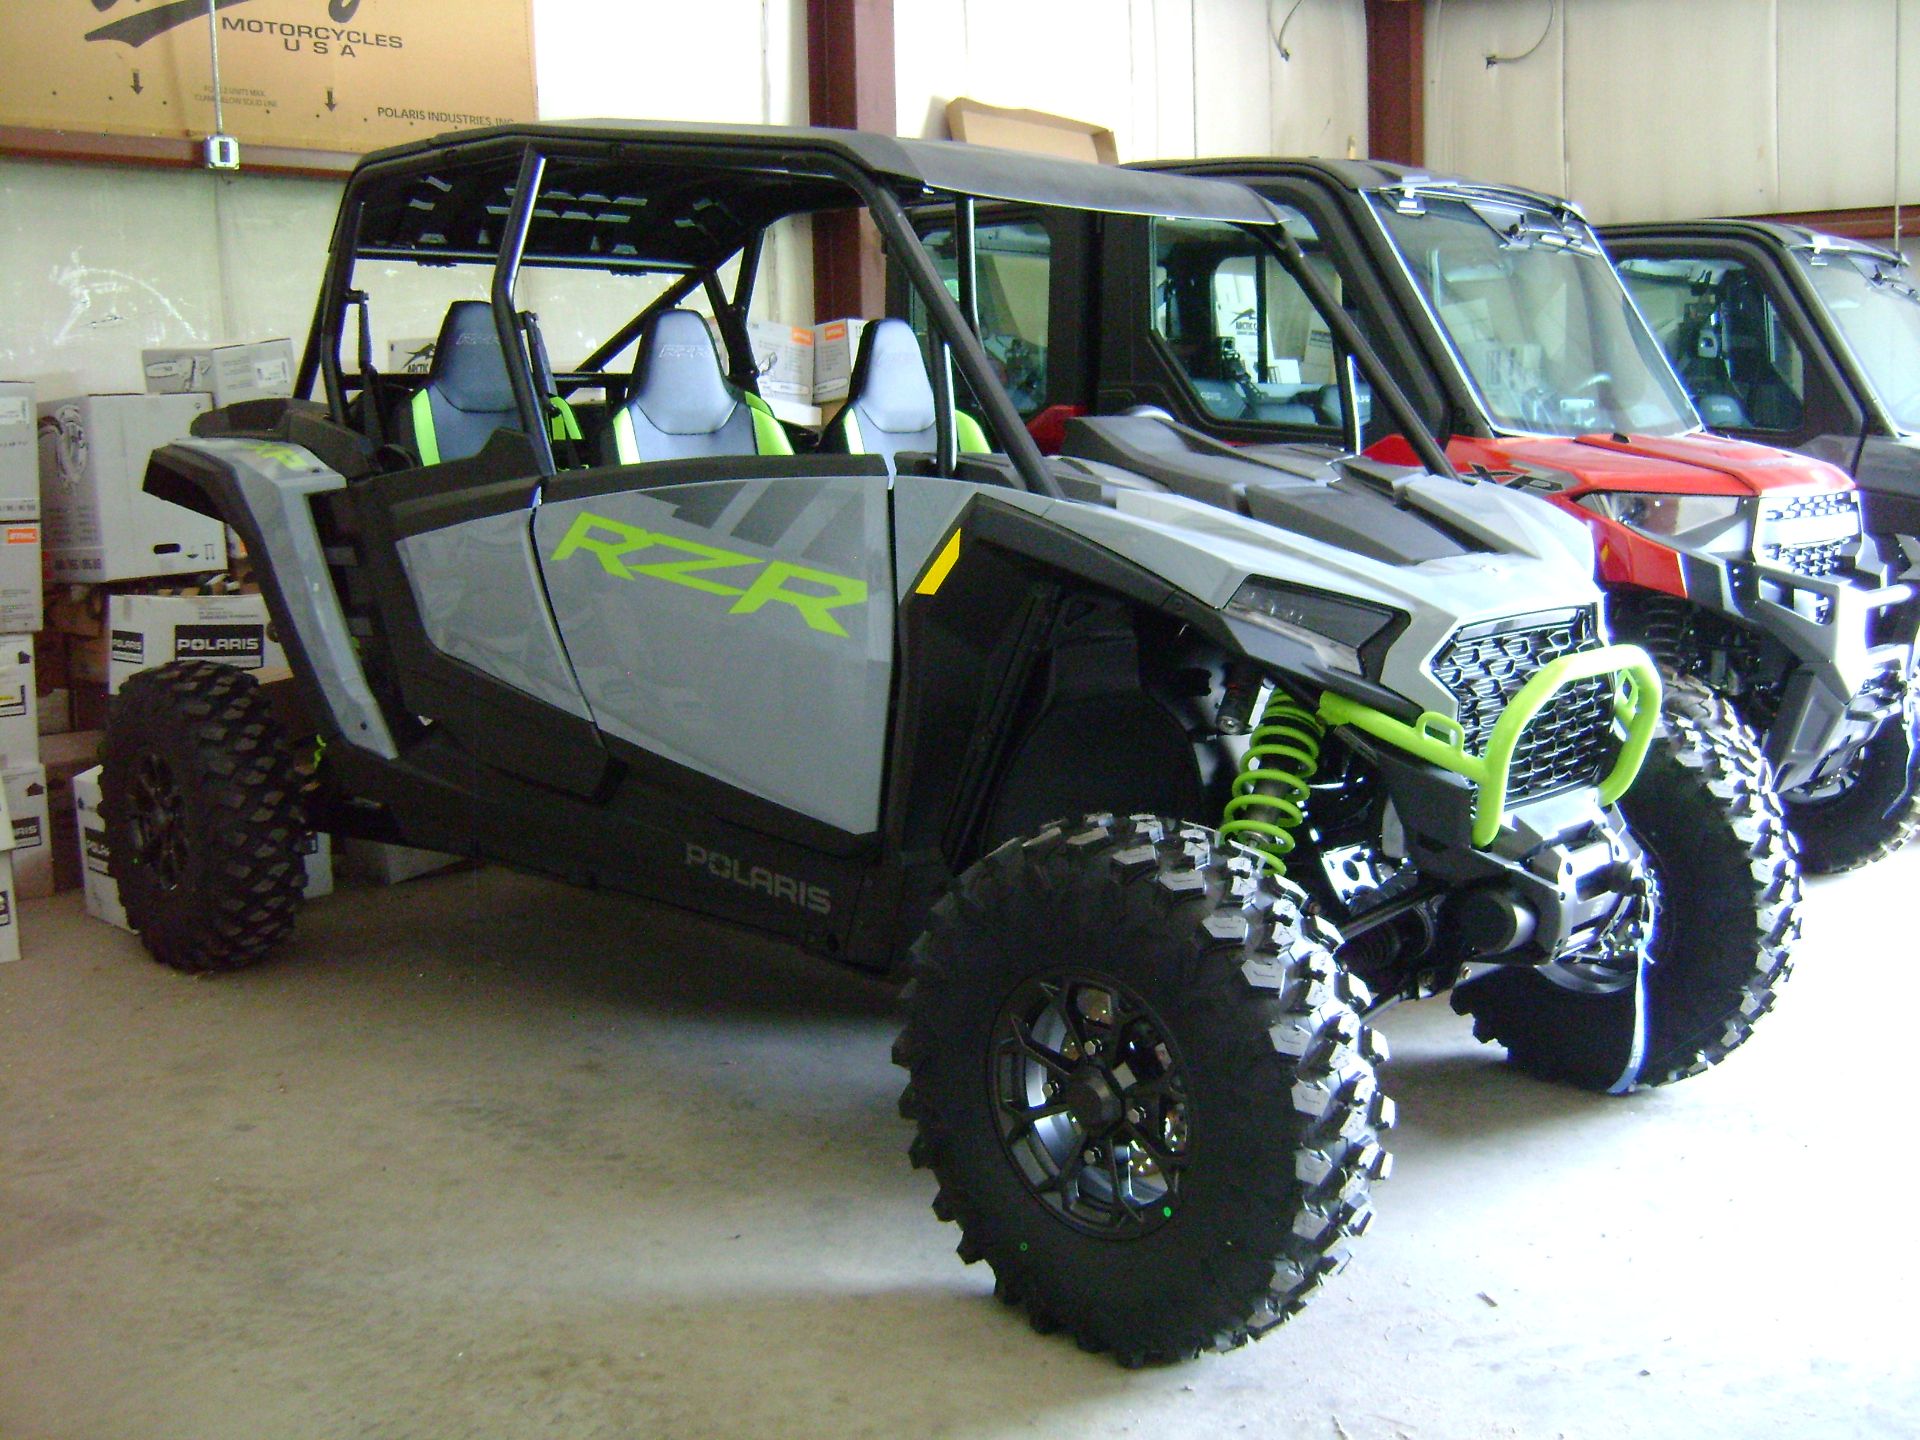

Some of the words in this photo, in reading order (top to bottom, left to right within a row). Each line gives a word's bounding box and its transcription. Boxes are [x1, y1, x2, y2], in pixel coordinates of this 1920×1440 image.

[222, 17, 403, 48] MOTORCYCLES
[377, 107, 425, 120] POLARIS
[1459, 463, 1564, 492] XP
[551, 511, 868, 637] RZR
[177, 638, 259, 651] POLARIS
[685, 842, 831, 915] POLARIS
